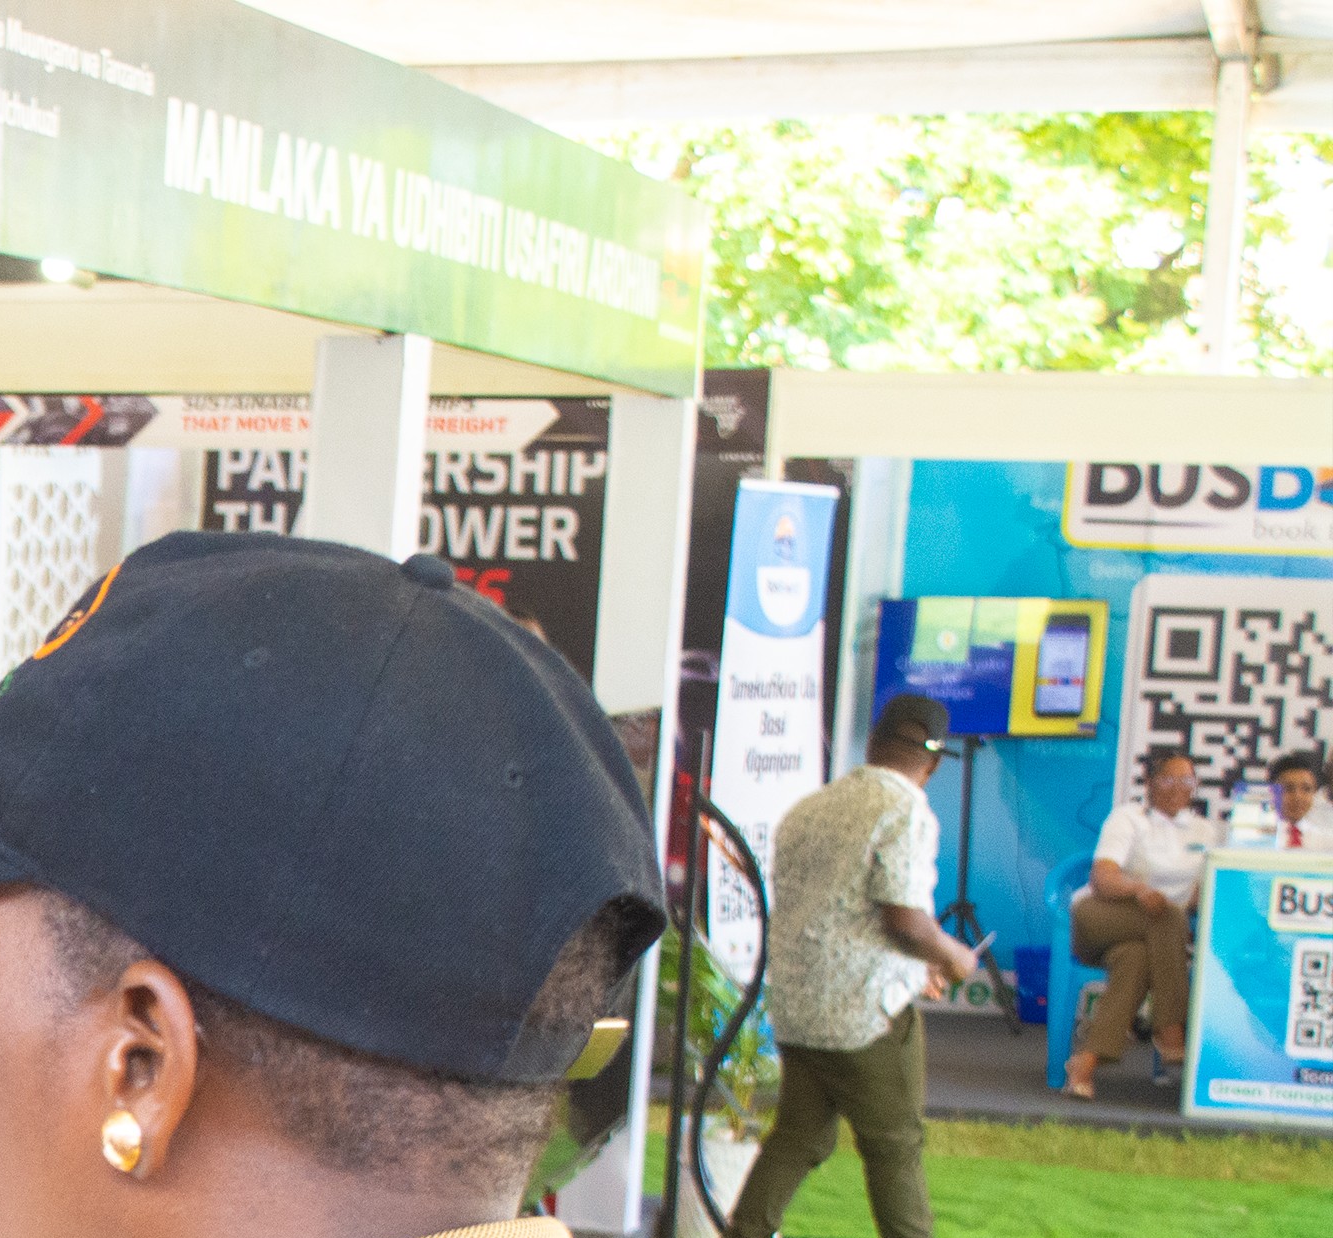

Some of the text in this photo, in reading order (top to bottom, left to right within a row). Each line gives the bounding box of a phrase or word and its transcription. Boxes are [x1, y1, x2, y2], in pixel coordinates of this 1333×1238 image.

[163, 96, 663, 322] MAMLAKA YA UDHIBITI USAFIRI ARDHINI
[182, 415, 231, 432] THAT
[236, 415, 293, 432] MOVE
[418, 503, 581, 562] OWER
